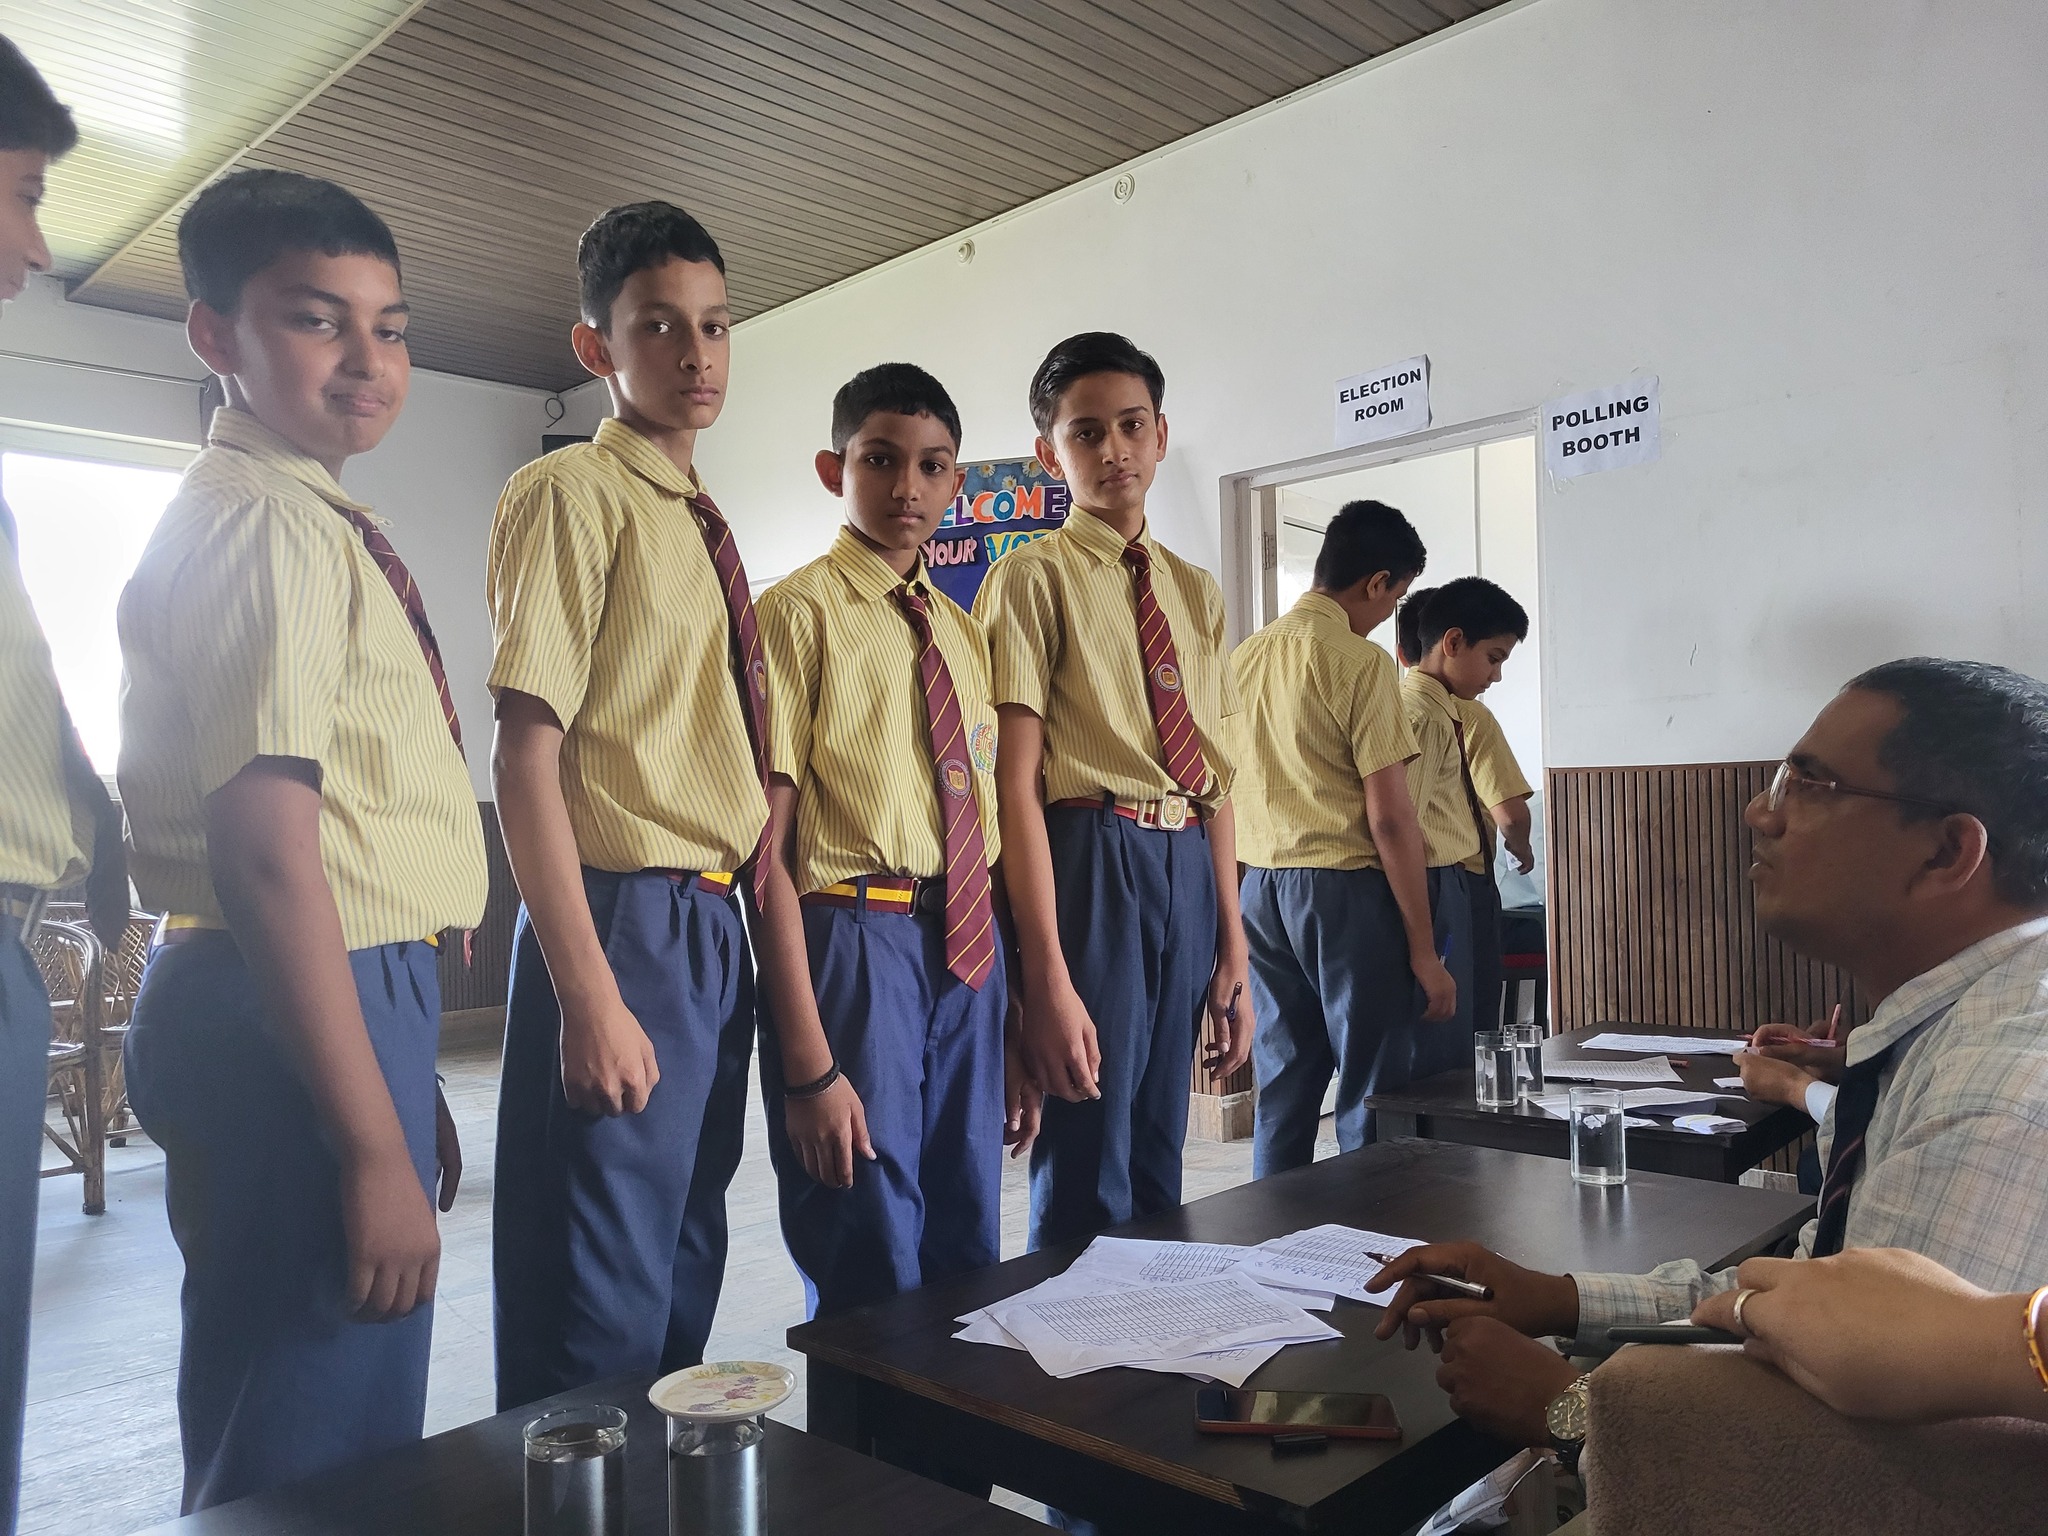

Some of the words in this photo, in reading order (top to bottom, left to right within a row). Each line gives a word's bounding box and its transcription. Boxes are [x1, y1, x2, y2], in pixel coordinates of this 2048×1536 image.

[1339, 367, 1421, 404] ELECTION
[1354, 397, 1404, 422] ROOM
[1552, 395, 1649, 432] POLLING
[1562, 426, 1640, 457] BOOTH
[938, 485, 1067, 528] LCOME
[920, 538, 978, 568] YOUR
